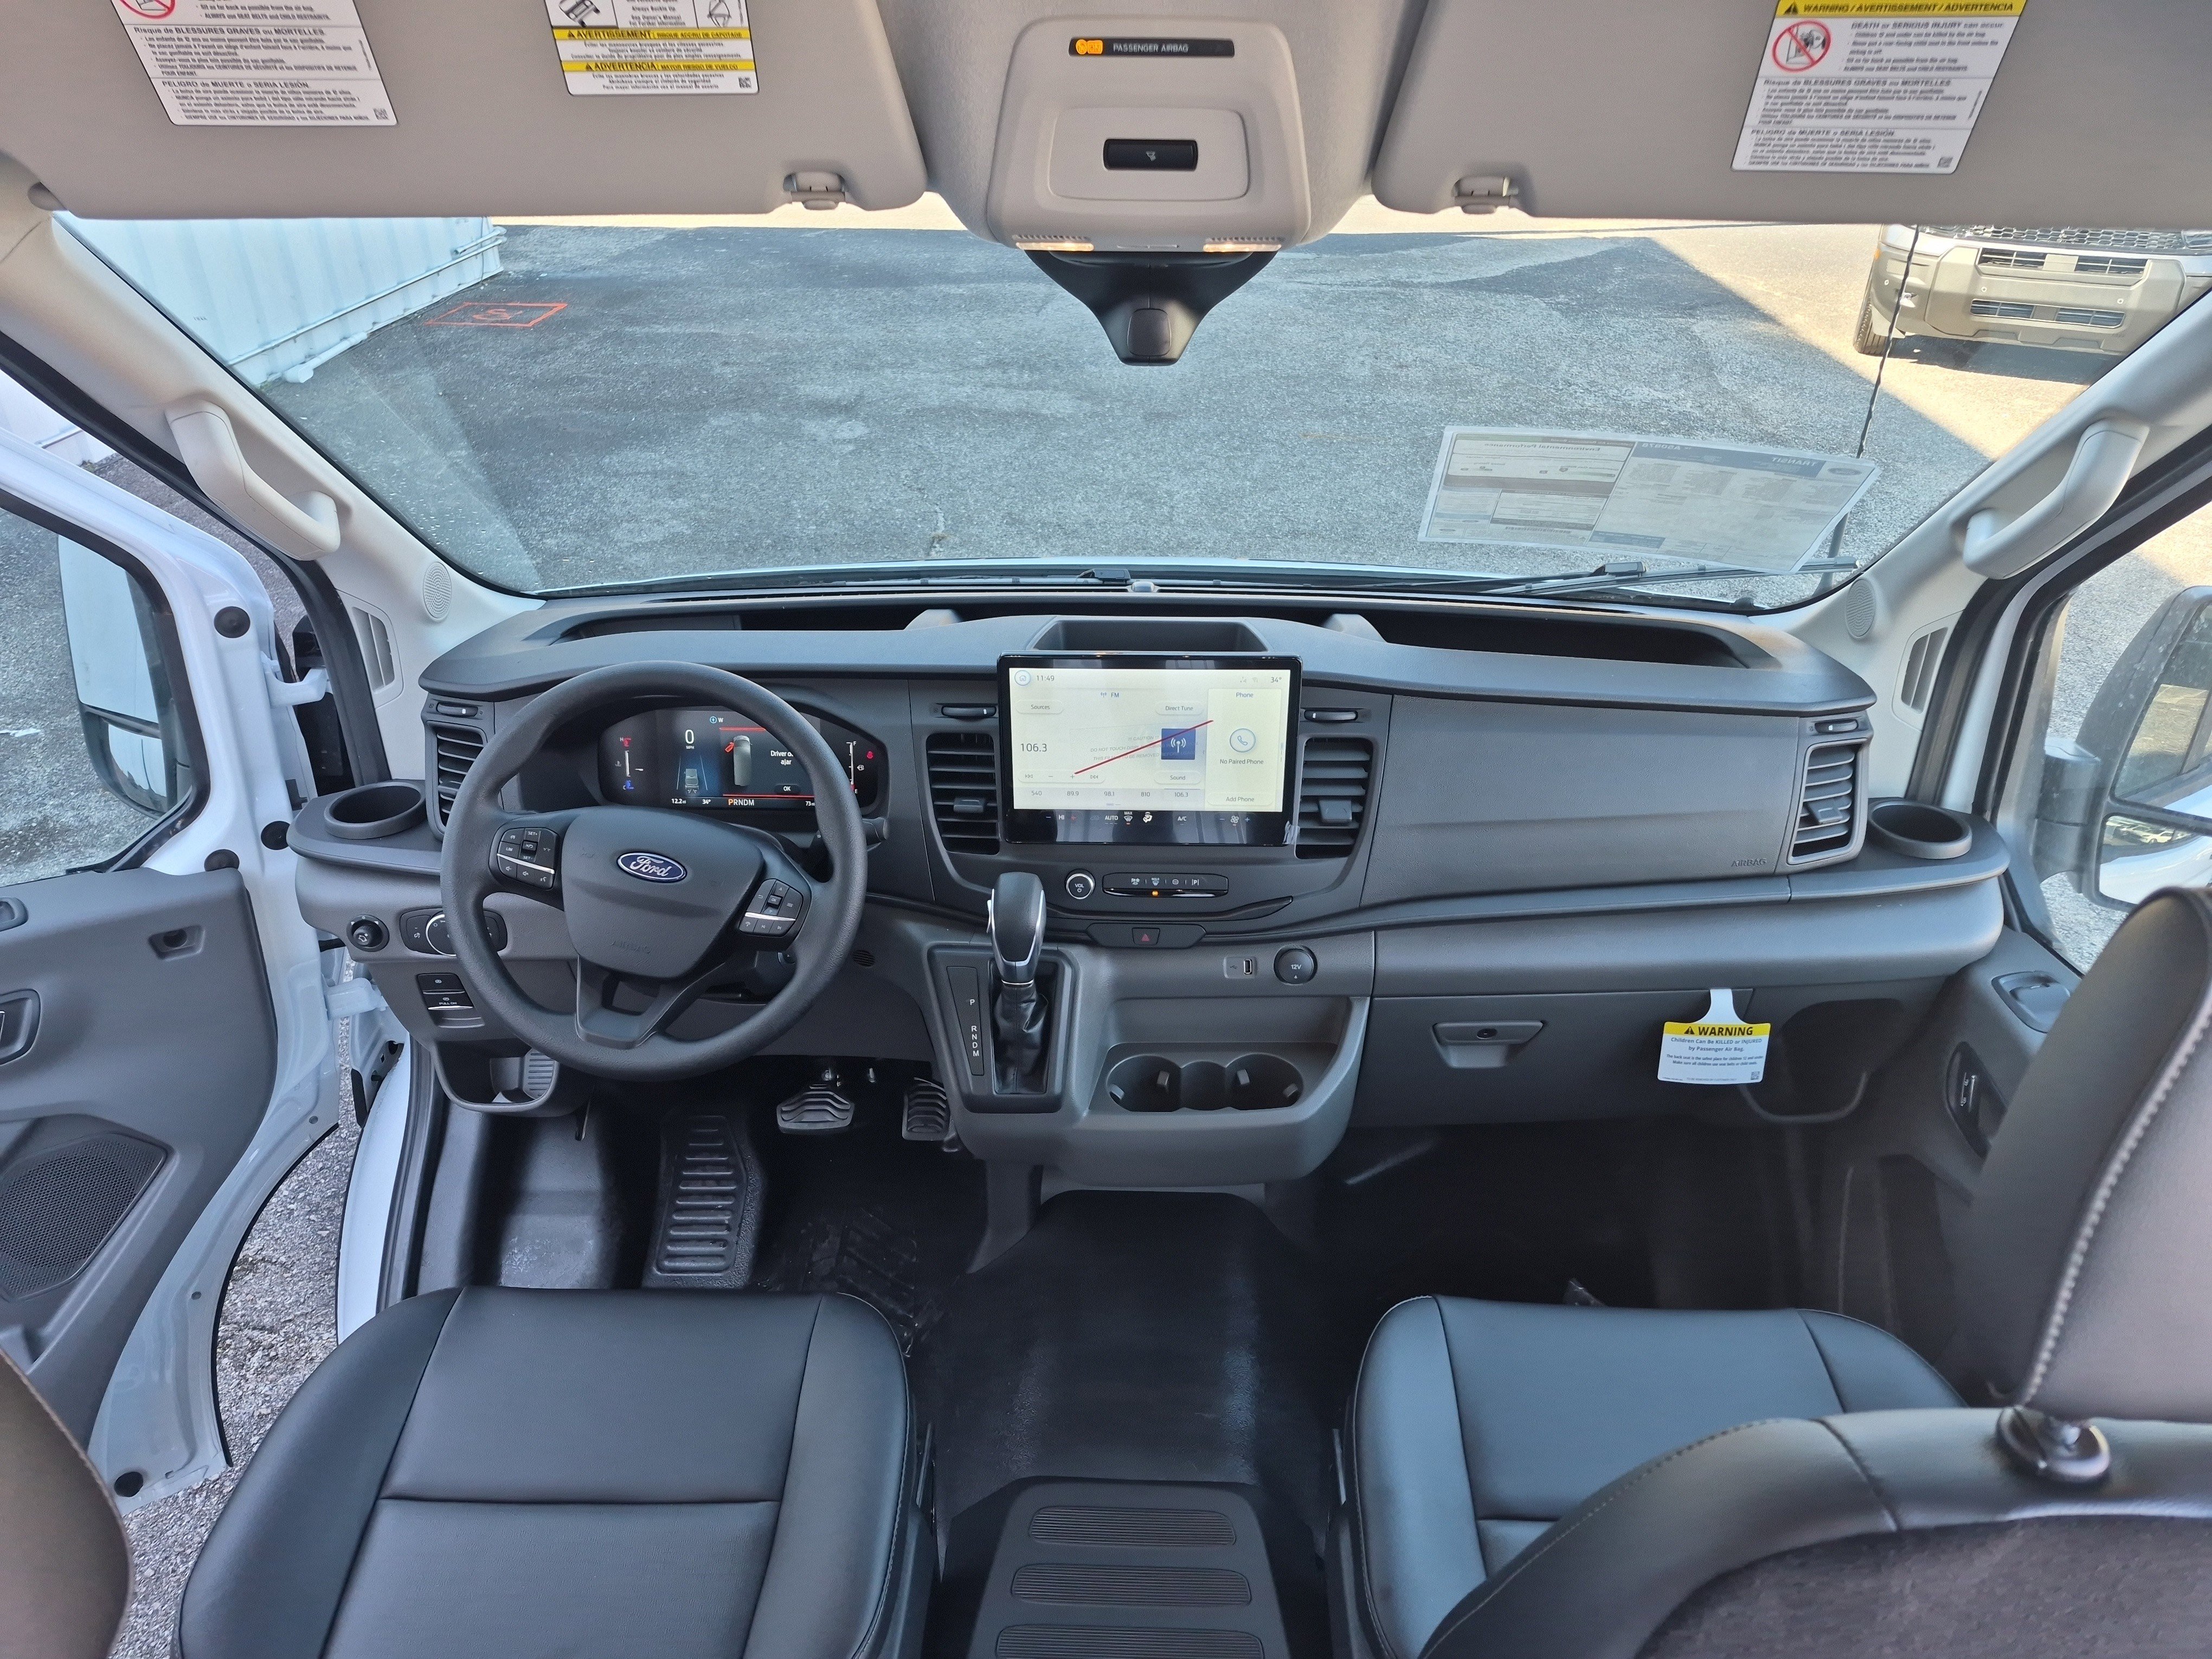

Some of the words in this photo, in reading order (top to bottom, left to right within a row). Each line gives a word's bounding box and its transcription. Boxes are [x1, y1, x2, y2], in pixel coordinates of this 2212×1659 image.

[1113, 43, 1159, 53] PASSENGER
[1161, 43, 1189, 53] AIRBAG
[685, 729, 695, 744] 0
[1020, 743, 1047, 752] 106.3
[629, 856, 672, 877] Ford
[1731, 858, 1767, 867] AIRBAG
[1698, 1026, 1753, 1036] WARNING
